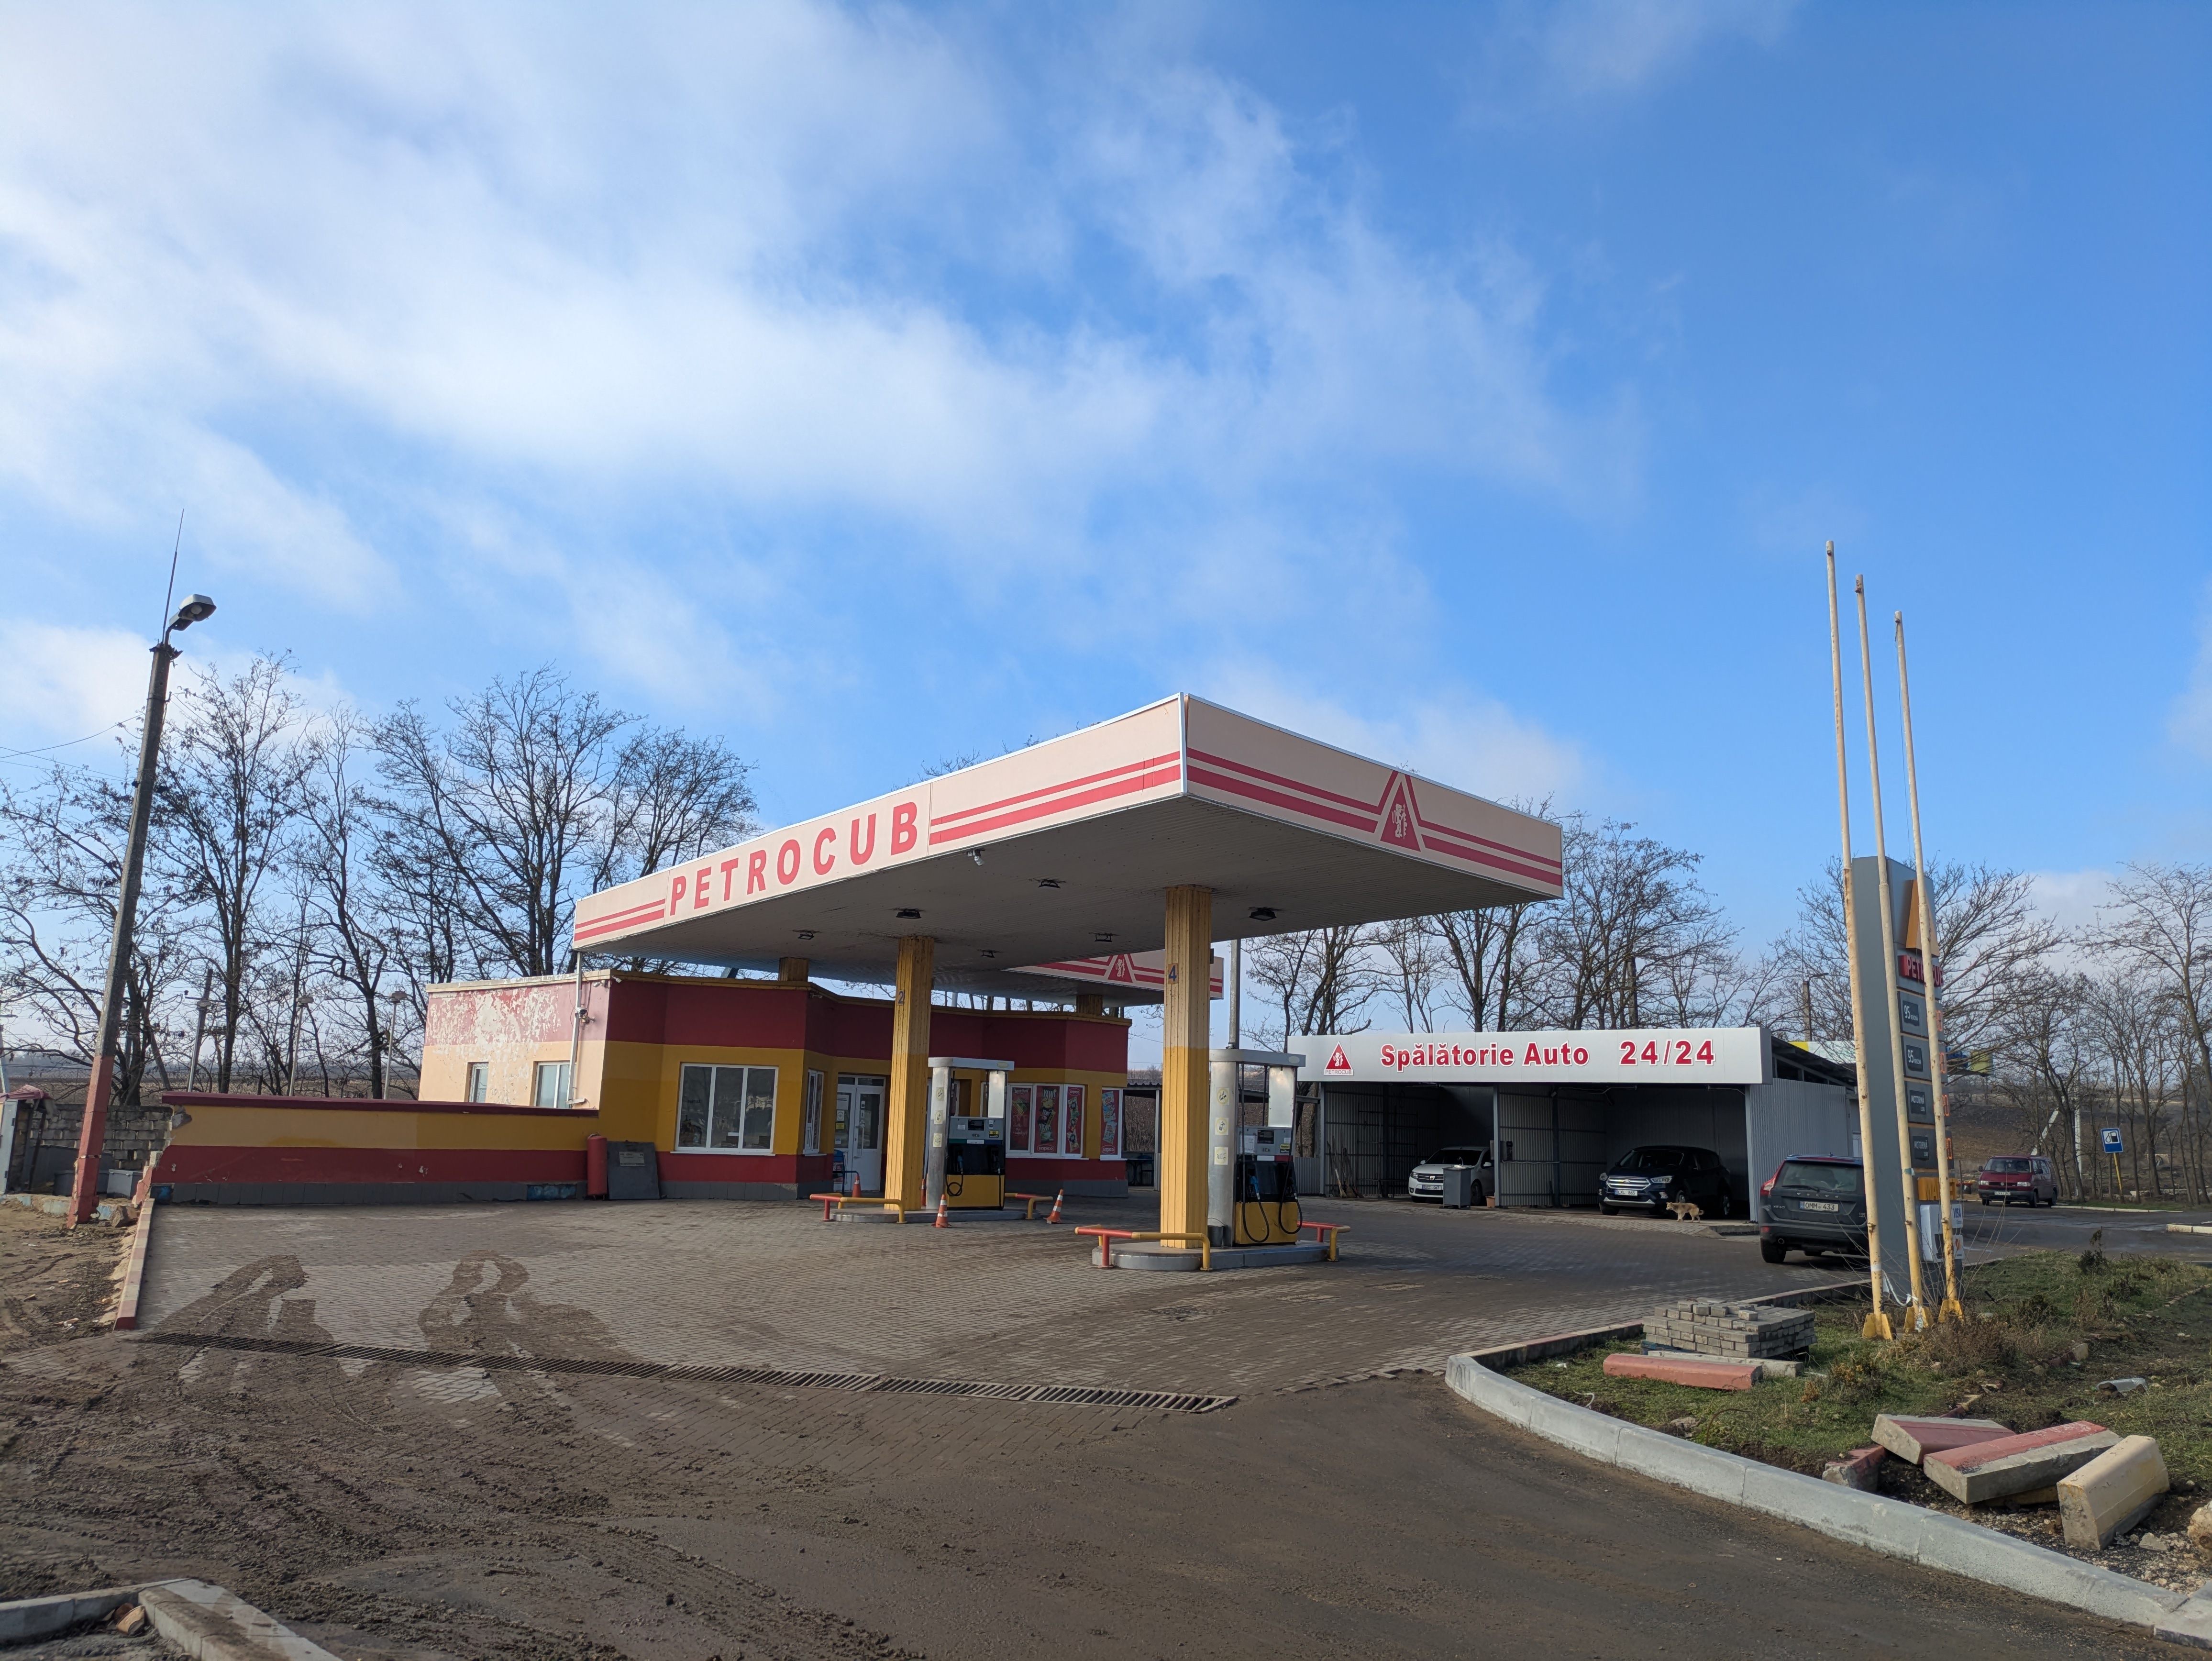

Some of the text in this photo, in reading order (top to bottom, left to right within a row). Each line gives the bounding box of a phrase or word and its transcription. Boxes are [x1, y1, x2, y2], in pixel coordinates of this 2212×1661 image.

[670, 802, 918, 916] PETROCUB
[1169, 965, 1177, 982] 4
[1904, 1005, 1911, 1019] 95
[1381, 1039, 1715, 1072] Spălătorie Auto 24/24
[1907, 1049, 1914, 1063] 95
[1953, 1207, 1961, 1218] VISA
